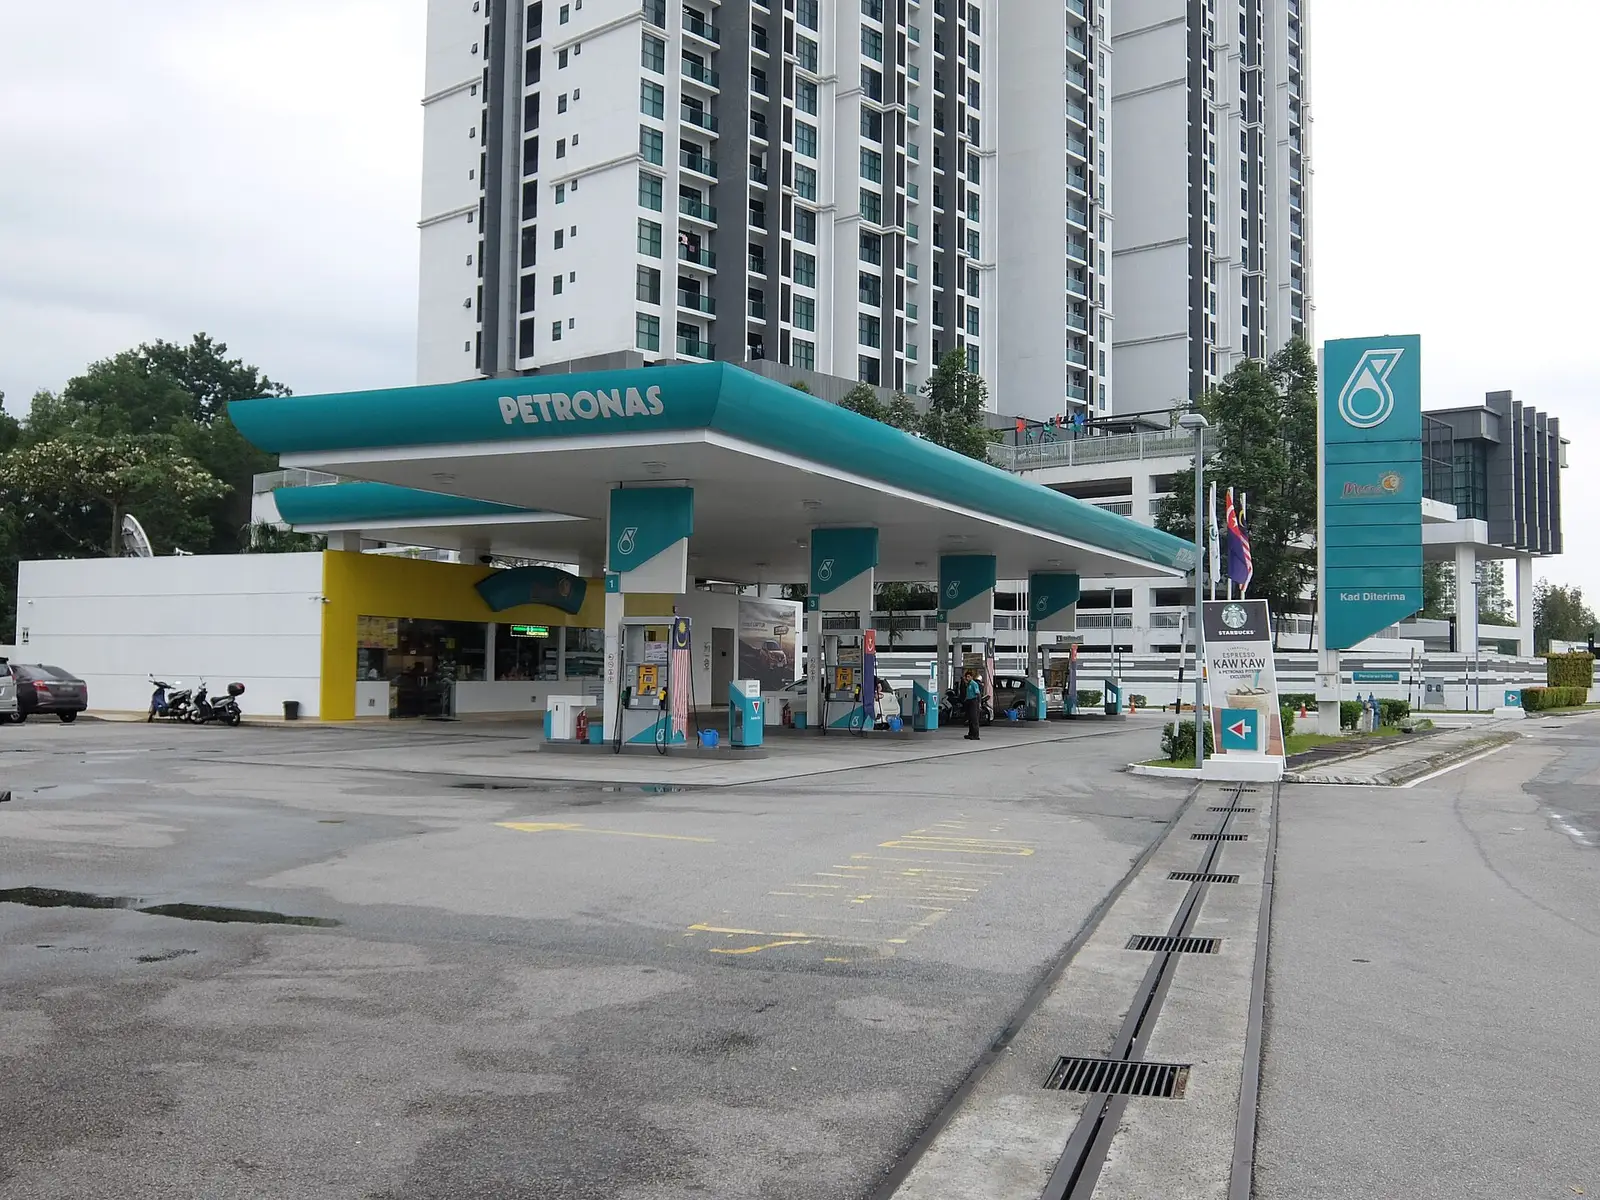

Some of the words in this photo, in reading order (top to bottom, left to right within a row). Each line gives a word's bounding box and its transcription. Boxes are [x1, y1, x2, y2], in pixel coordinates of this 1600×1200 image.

[498, 385, 665, 425] PETRONAS
[1340, 593, 1360, 601] Kad
[1363, 592, 1406, 601] Diterima
[1213, 659, 1239, 669] KAW
[1241, 659, 1265, 668] KAW
